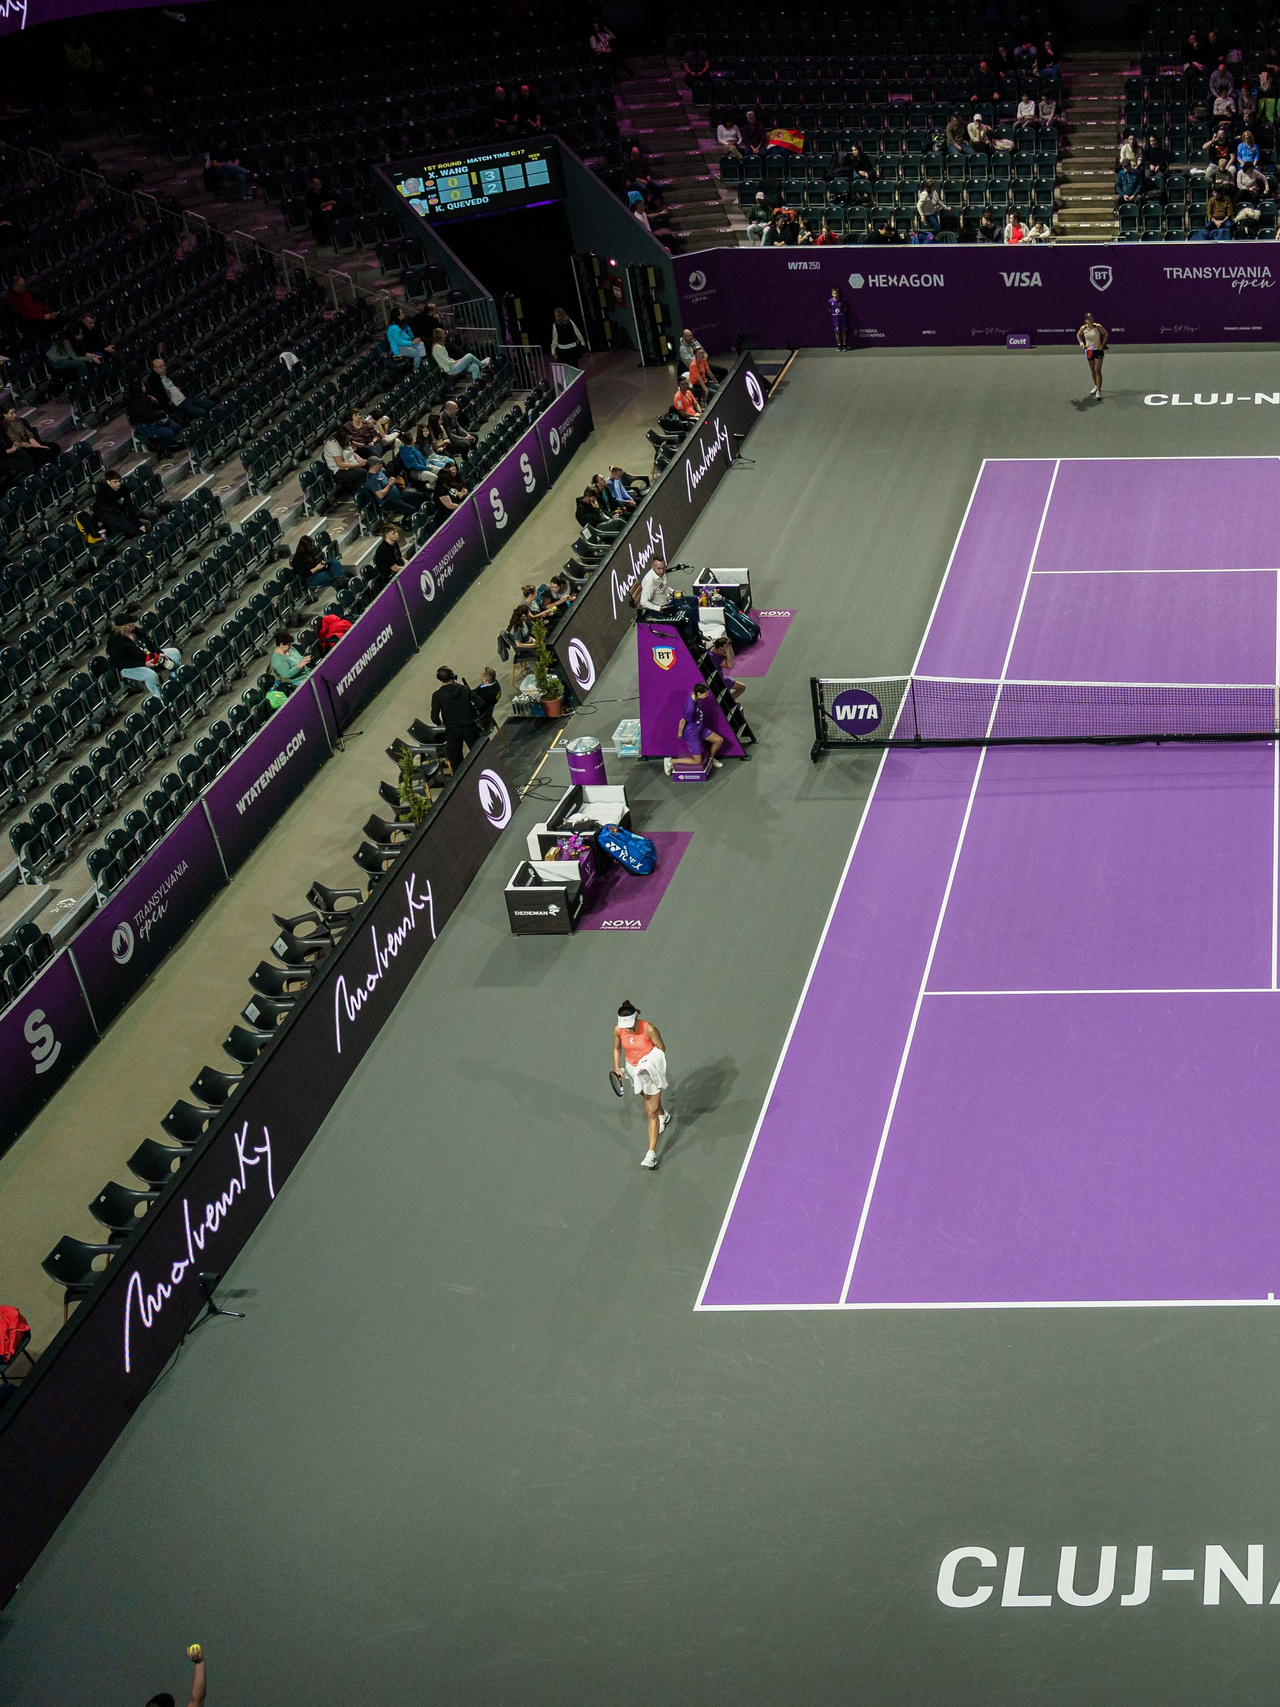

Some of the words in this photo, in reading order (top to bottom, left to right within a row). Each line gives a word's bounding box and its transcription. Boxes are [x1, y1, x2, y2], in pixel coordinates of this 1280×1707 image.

[438, 161, 462, 169] ROUND
[467, 155, 492, 164] MATCH
[440, 166, 468, 176] WANG
[484, 171, 495, 180] 3
[448, 178, 458, 188] 0
[487, 184, 498, 194] 2
[450, 190, 460, 200] 0
[447, 196, 490, 210] QUEVEDO
[999, 272, 1042, 286] VISA
[1094, 272, 1108, 280] BT
[1163, 266, 1272, 279] TRANSYLVANIA
[868, 274, 944, 287] HEXAGON
[1231, 278, 1276, 294] open
[1010, 337, 1026, 345] Cavit
[433, 536, 465, 576] TRANSYLVANIA
[437, 564, 454, 591] open
[336, 624, 394, 696] WTATENNIS.COM
[658, 651, 671, 660] BT
[836, 704, 878, 720] WTA
[236, 728, 306, 815] WTATENNIS.COM
[134, 860, 188, 926] TRANSYLVANIA
[139, 900, 168, 942] open
